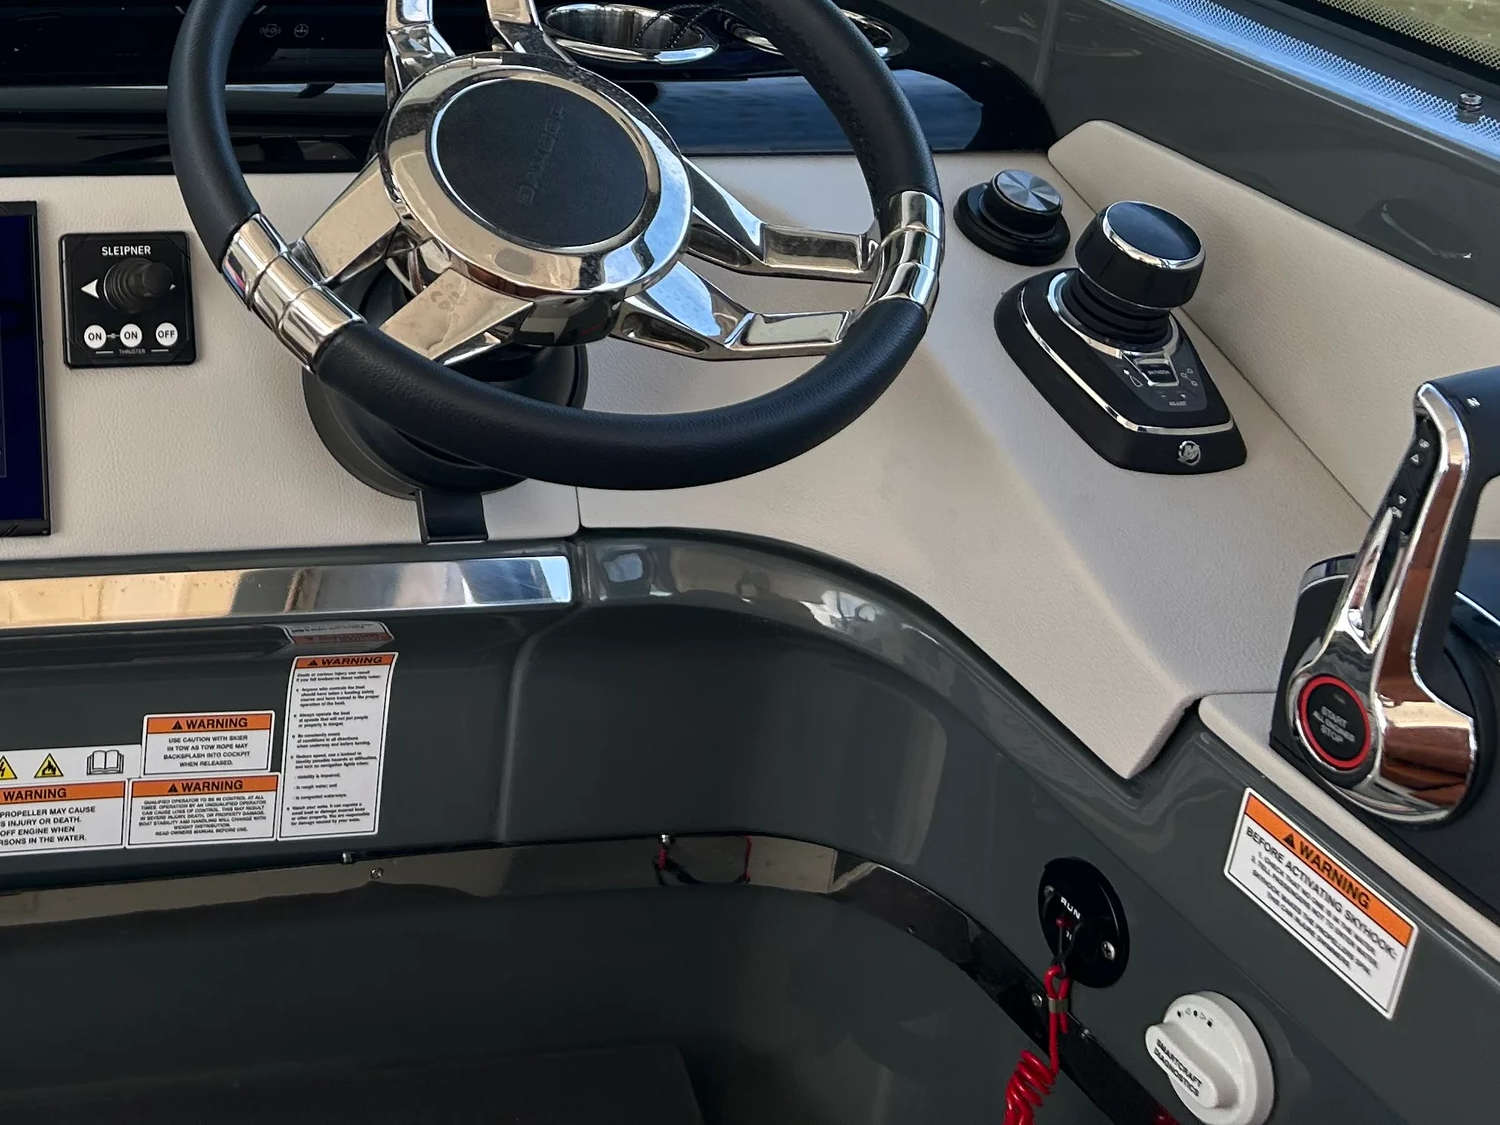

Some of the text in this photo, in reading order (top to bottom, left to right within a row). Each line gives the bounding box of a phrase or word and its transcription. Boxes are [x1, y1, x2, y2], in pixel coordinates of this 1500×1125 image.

[101, 245, 152, 256] SLEIPNER
[87, 332, 102, 341] ON
[123, 331, 138, 340] ON
[157, 329, 175, 338] OFF
[321, 656, 383, 666] WARNING
[186, 717, 248, 730] WARNING
[1320, 706, 1349, 729] START
[182, 735, 211, 743] CAUTION
[1320, 725, 1344, 743] STOP
[181, 779, 243, 792] WARNING
[3, 788, 67, 802] WARNING
[0, 809, 48, 819] PROPELLER
[49, 807, 65, 816] MAY
[66, 805, 96, 815] CAUSE
[7, 818, 36, 828] INJURY
[39, 817, 51, 825] OR
[53, 816, 82, 825] DEATH.
[0, 829, 16, 837] OFF
[18, 827, 49, 836] ENGINE
[50, 825, 75, 834] WHEN
[39, 836, 55, 844] THE
[57, 834, 87, 843] WATER.
[1245, 826, 1285, 864] BEFORE
[1285, 860, 1342, 913] ACTIVATING
[1299, 840, 1371, 910] WARNING
[1060, 896, 1081, 920] RUN
[1155, 1038, 1203, 1088] SMARTCRAFT
[1153, 1047, 1201, 1098] DIAGNOSTICS
